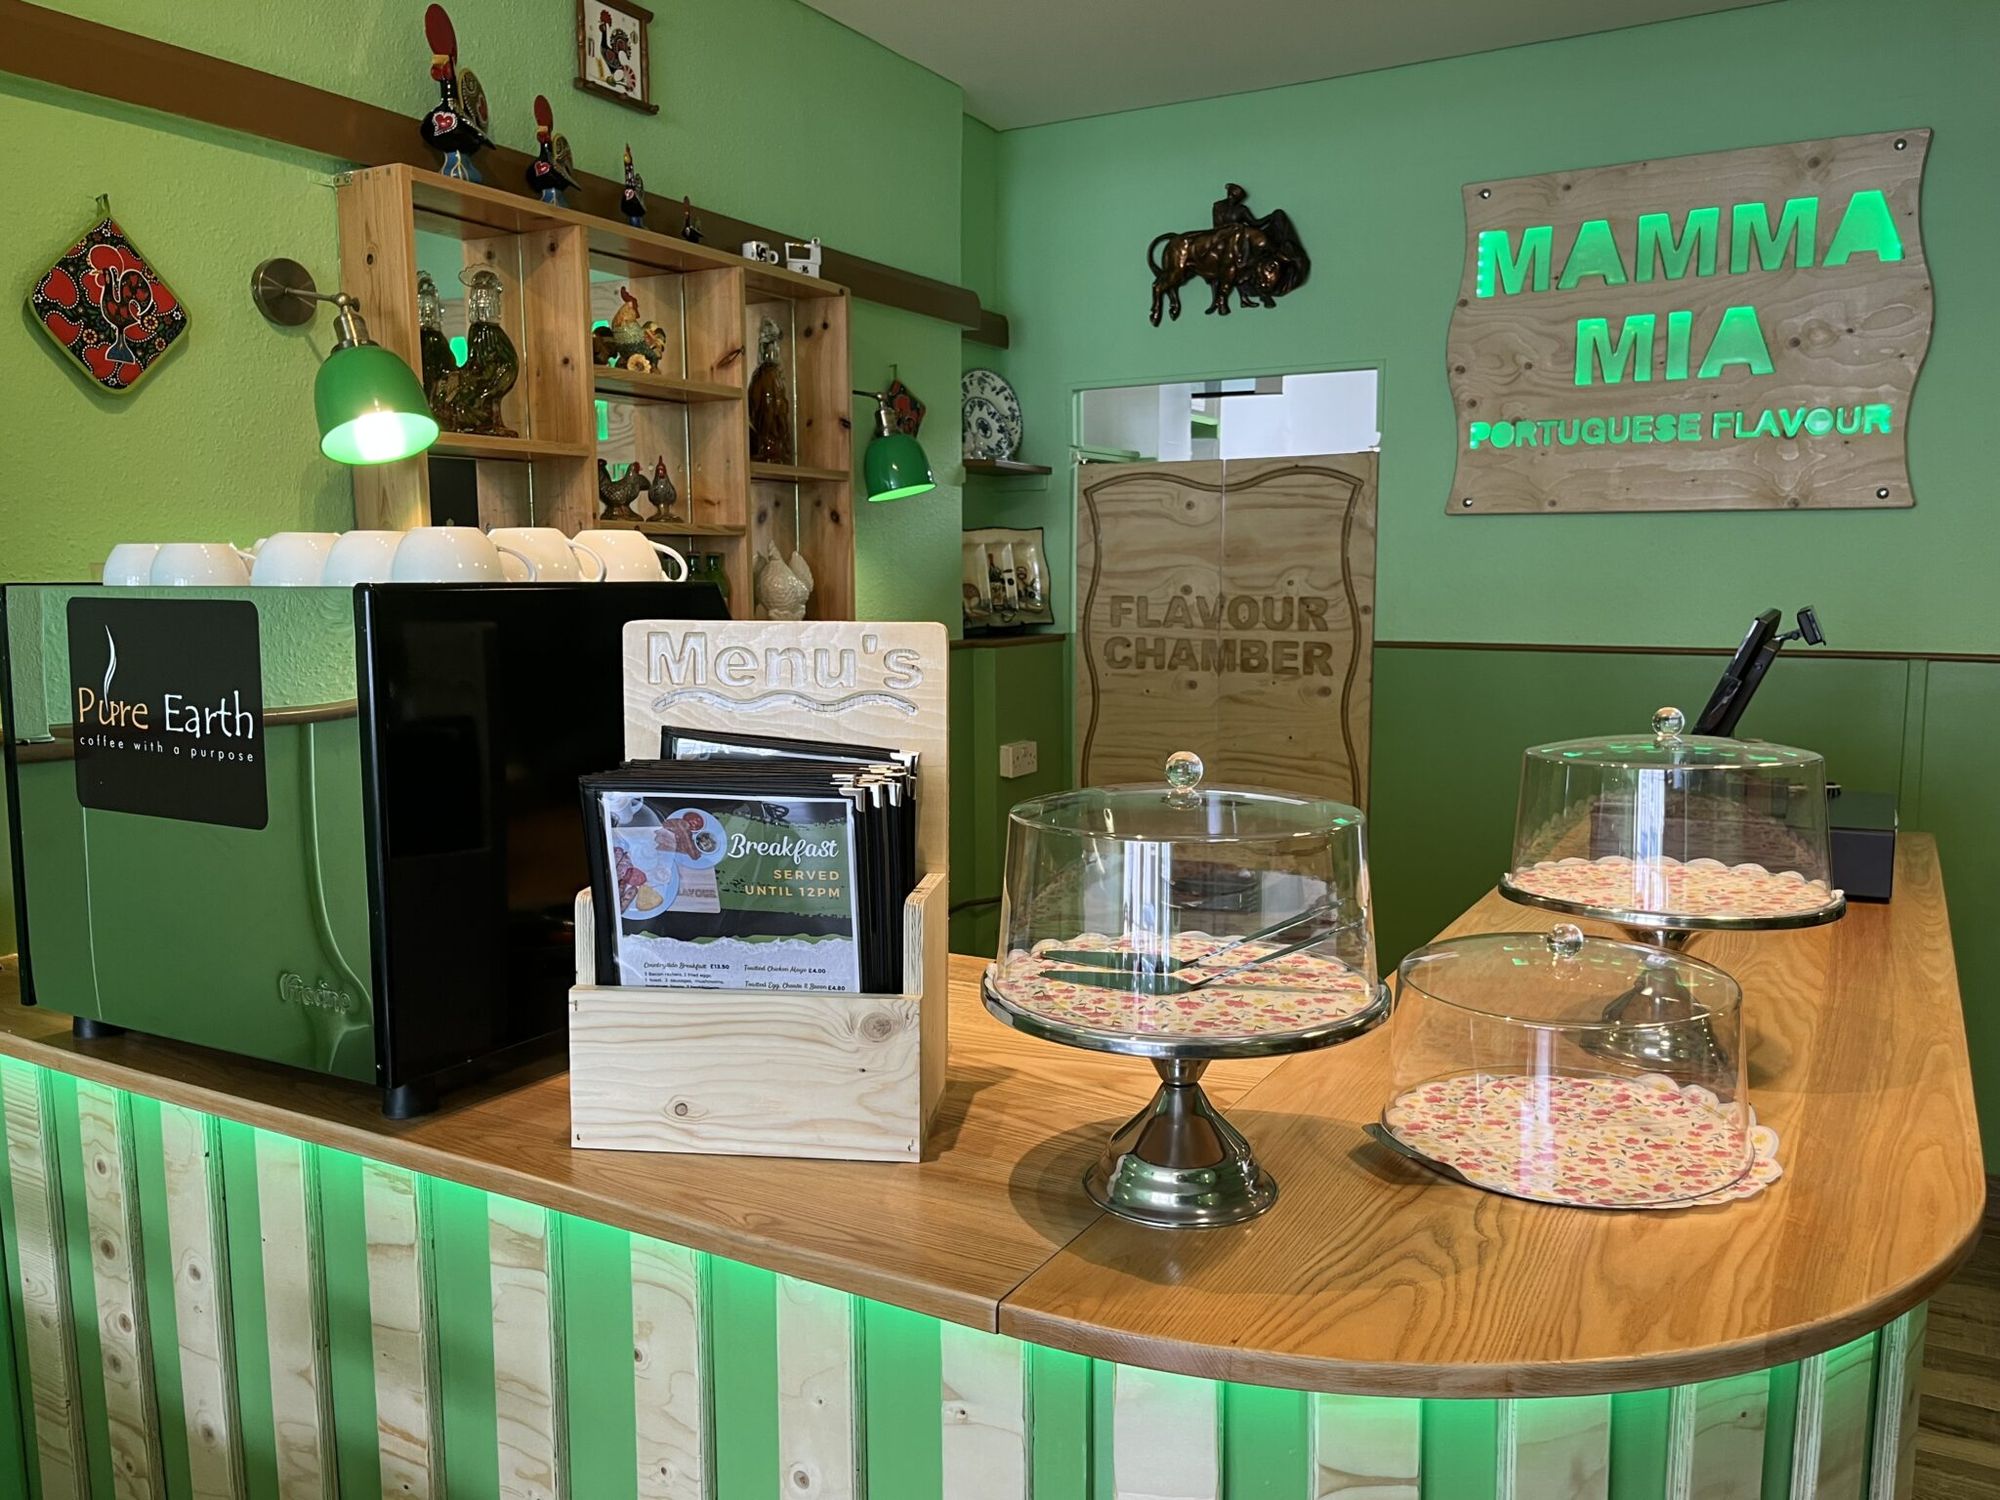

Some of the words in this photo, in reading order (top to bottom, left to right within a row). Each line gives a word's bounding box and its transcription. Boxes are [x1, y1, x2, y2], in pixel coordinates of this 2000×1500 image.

[1476, 189, 1906, 299] MAMMA
[1574, 305, 1776, 386] MIA
[1469, 412, 1701, 450] PORTUGUESE
[1711, 403, 1893, 440] FLAVOUR
[1109, 594, 1329, 632] FLAVOUR
[647, 631, 925, 690] Menu's
[1103, 635, 1334, 677] CHAMBER
[78, 686, 149, 730] Pure
[164, 689, 254, 740] Earth
[79, 734, 124, 750] coffee
[133, 740, 164, 753] with
[173, 745, 180, 755] a
[190, 747, 254, 763] purpose
[727, 832, 840, 865] Breakfast
[744, 885, 793, 897] UNTIL
[799, 887, 841, 898] 12PM
[773, 869, 840, 881] SERVED
